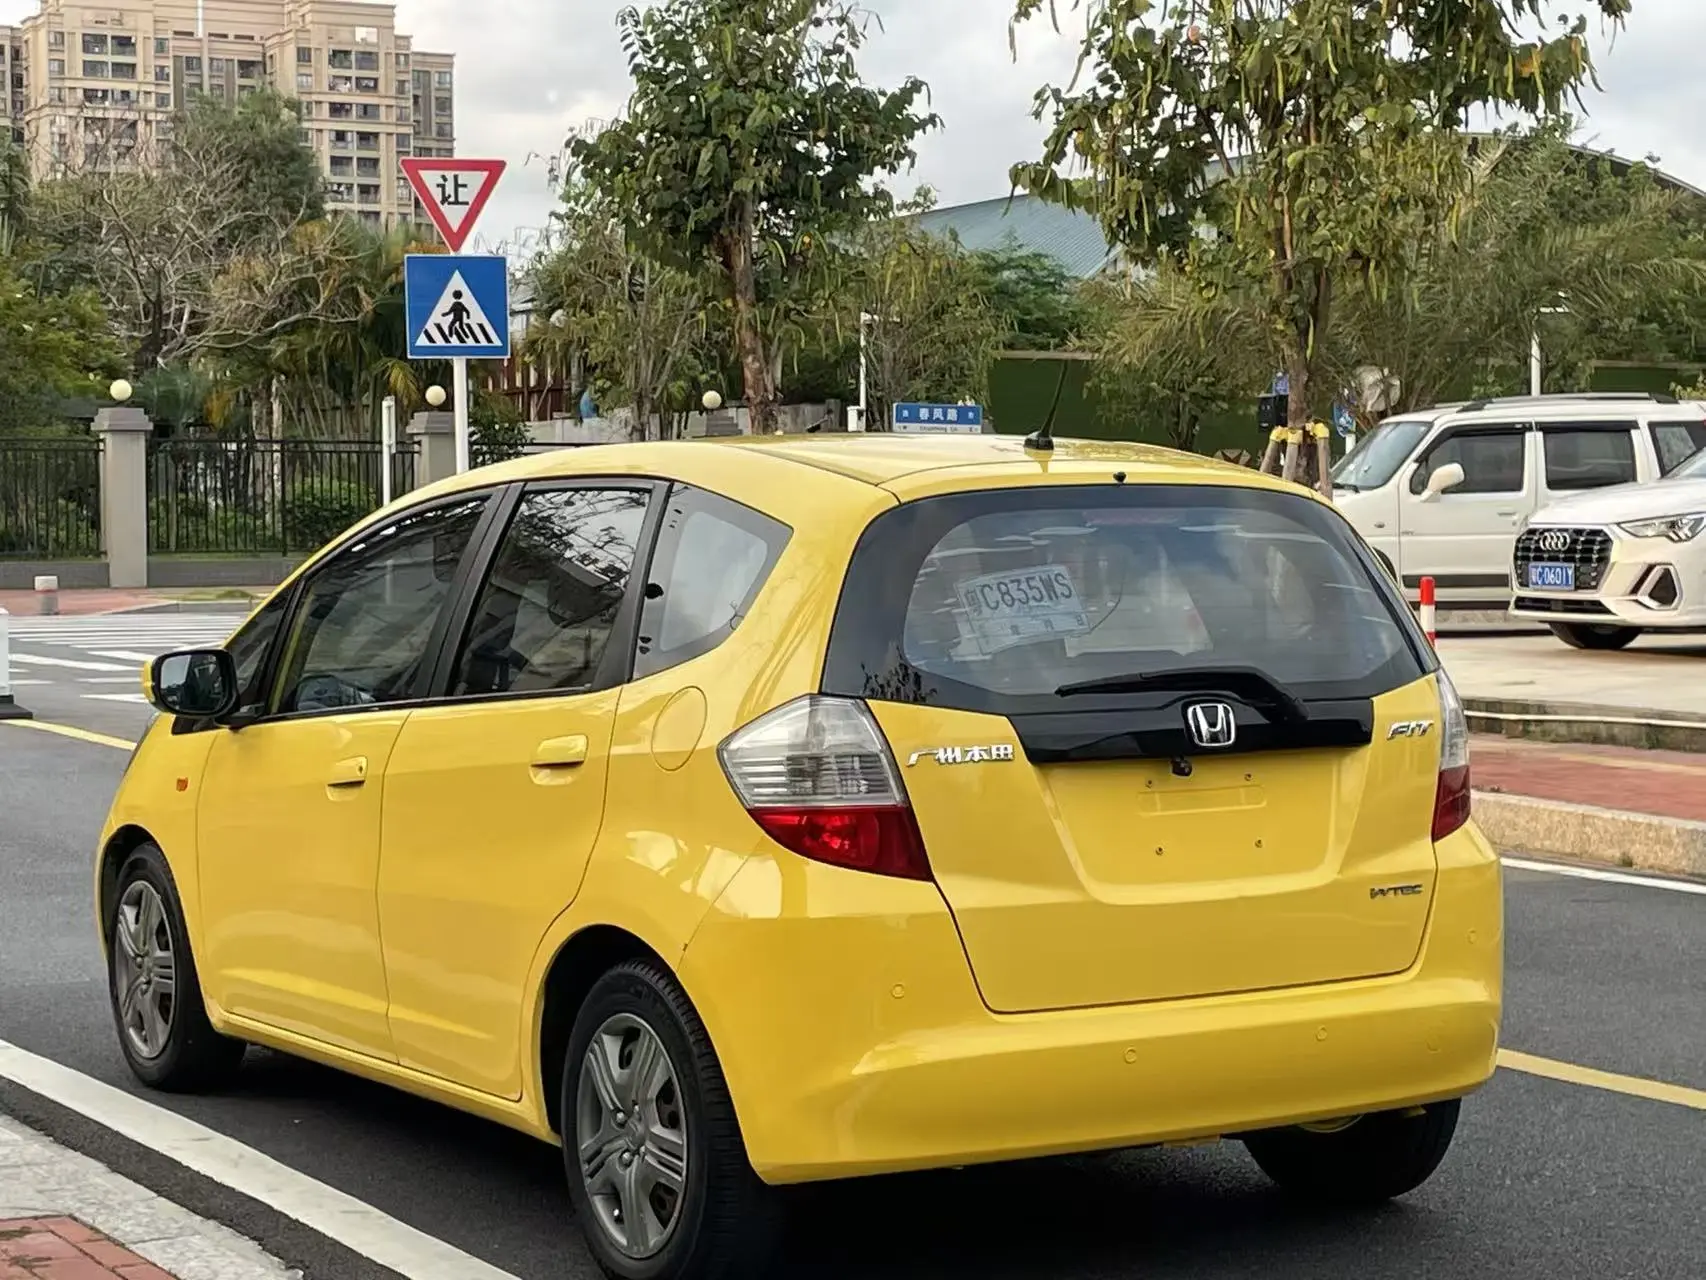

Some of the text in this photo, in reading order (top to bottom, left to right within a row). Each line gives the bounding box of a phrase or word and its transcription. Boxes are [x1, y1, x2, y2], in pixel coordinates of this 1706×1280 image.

[436, 174, 470, 206] 让
[919, 408, 959, 421] 春风路
[1387, 719, 1434, 740] FIT
[906, 745, 1014, 766] 广州本田
